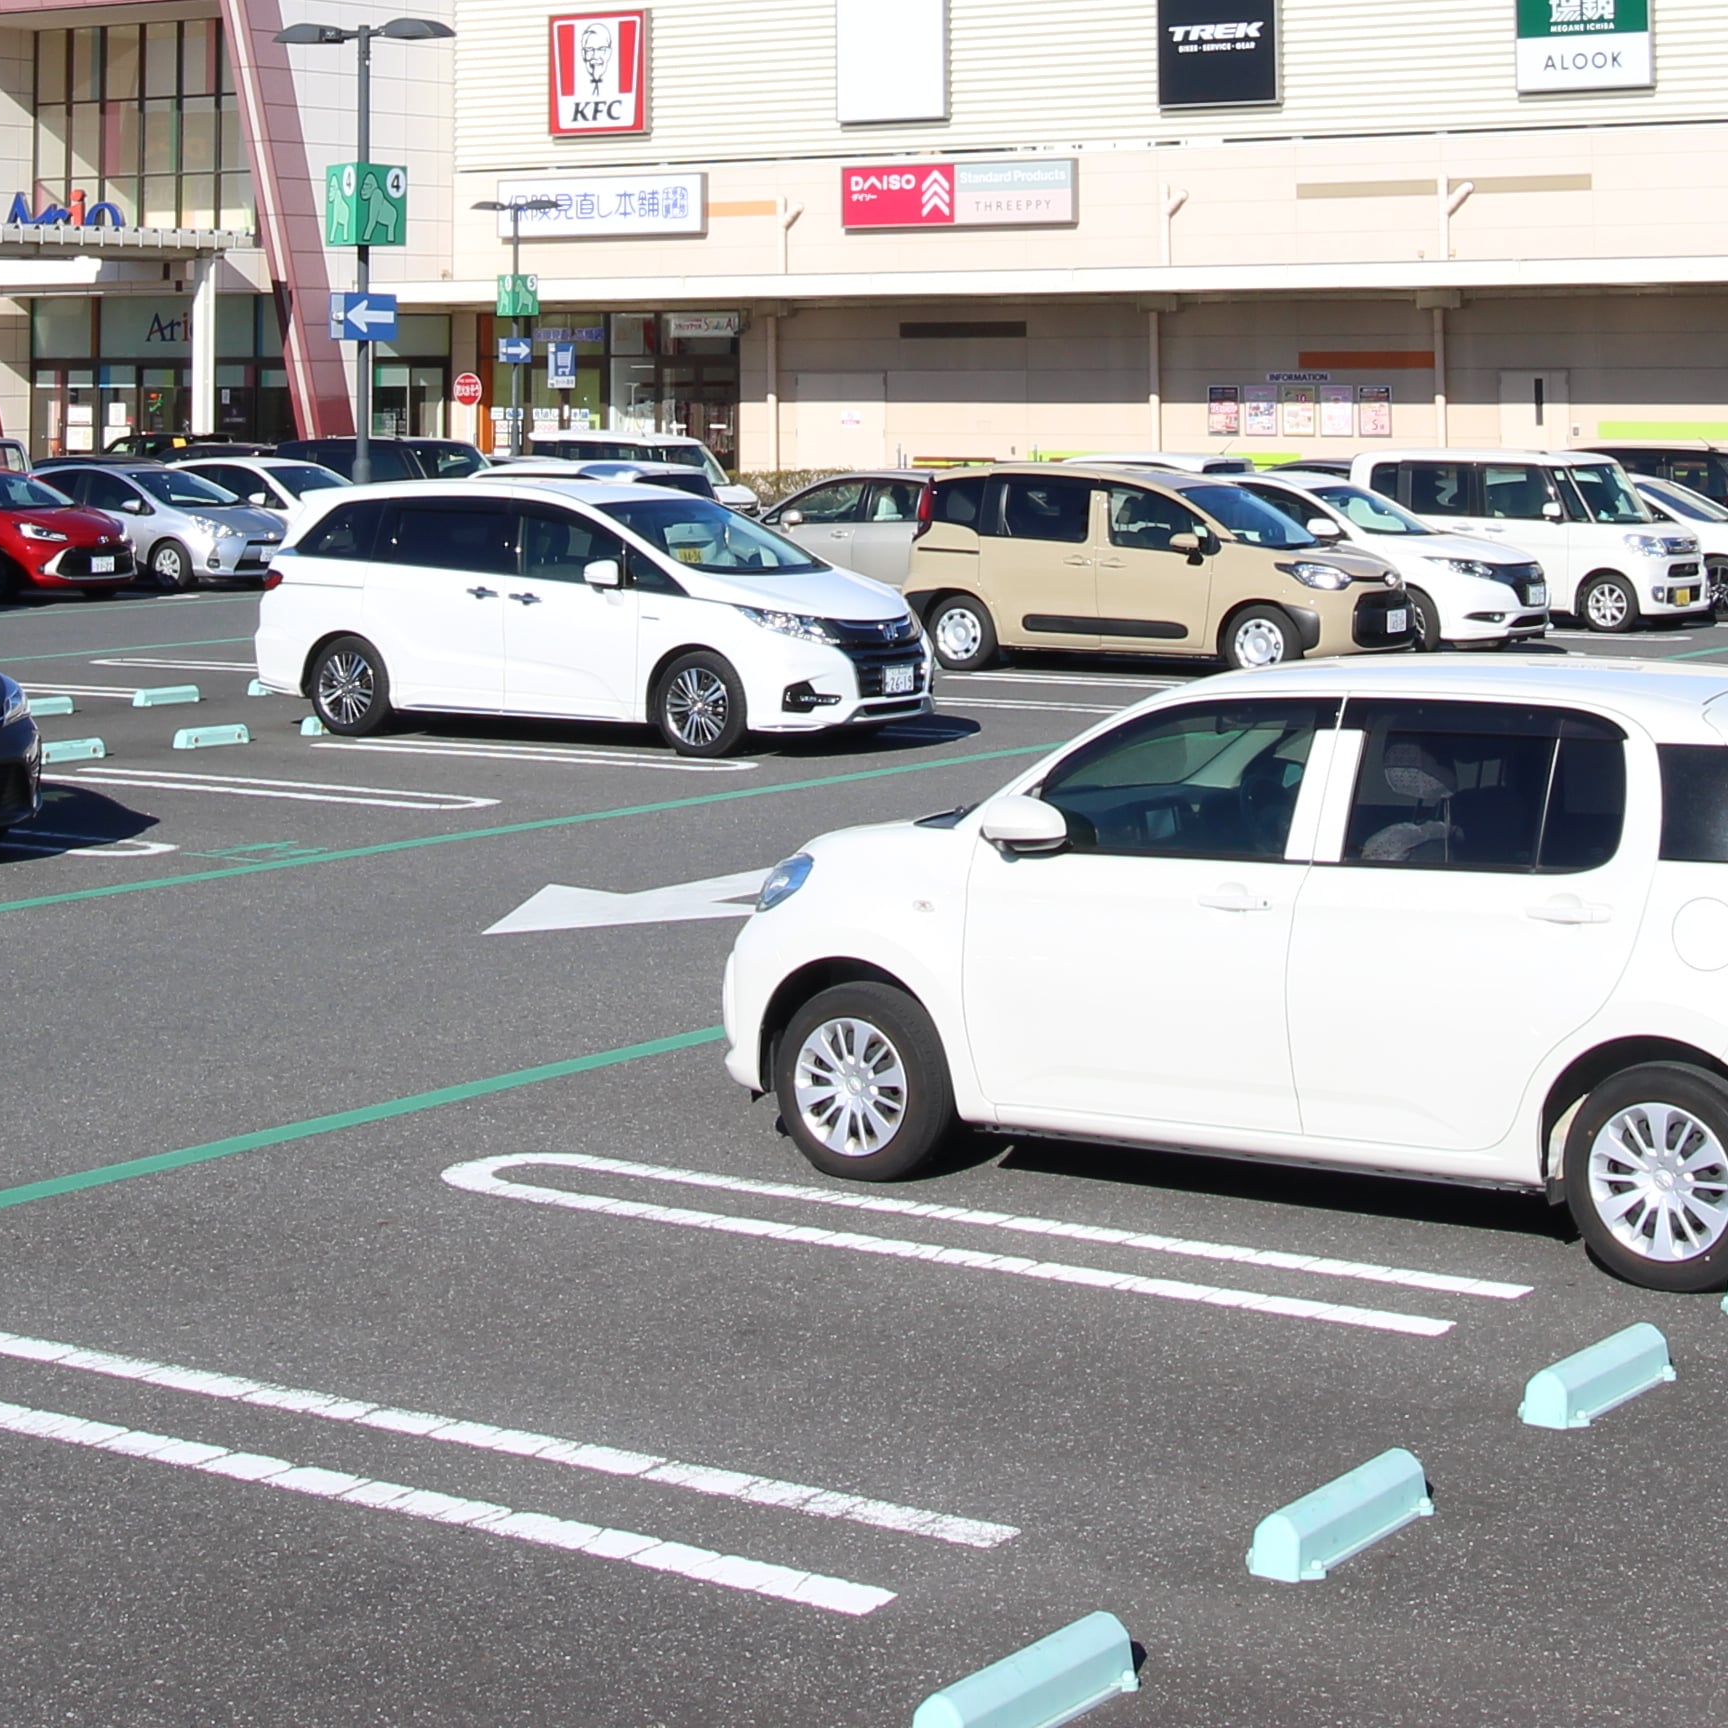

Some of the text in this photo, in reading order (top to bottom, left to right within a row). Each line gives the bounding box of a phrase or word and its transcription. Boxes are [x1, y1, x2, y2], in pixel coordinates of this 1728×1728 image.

[1168, 21, 1264, 42] TREK
[1550, 22, 1615, 33] MEGANE ICHIBA
[1202, 42, 1232, 52] SERVICE
[1235, 41, 1256, 50] GEAR
[1543, 50, 1623, 72] ALOOK
[571, 99, 623, 123] KFC
[390, 173, 401, 193] 4
[850, 174, 916, 192] DAISO
[959, 168, 1066, 184] Standard Products
[974, 199, 1052, 213] THREEPPY
[145, 312, 193, 343] Ari
[1268, 373, 1329, 382] INFORMATION
